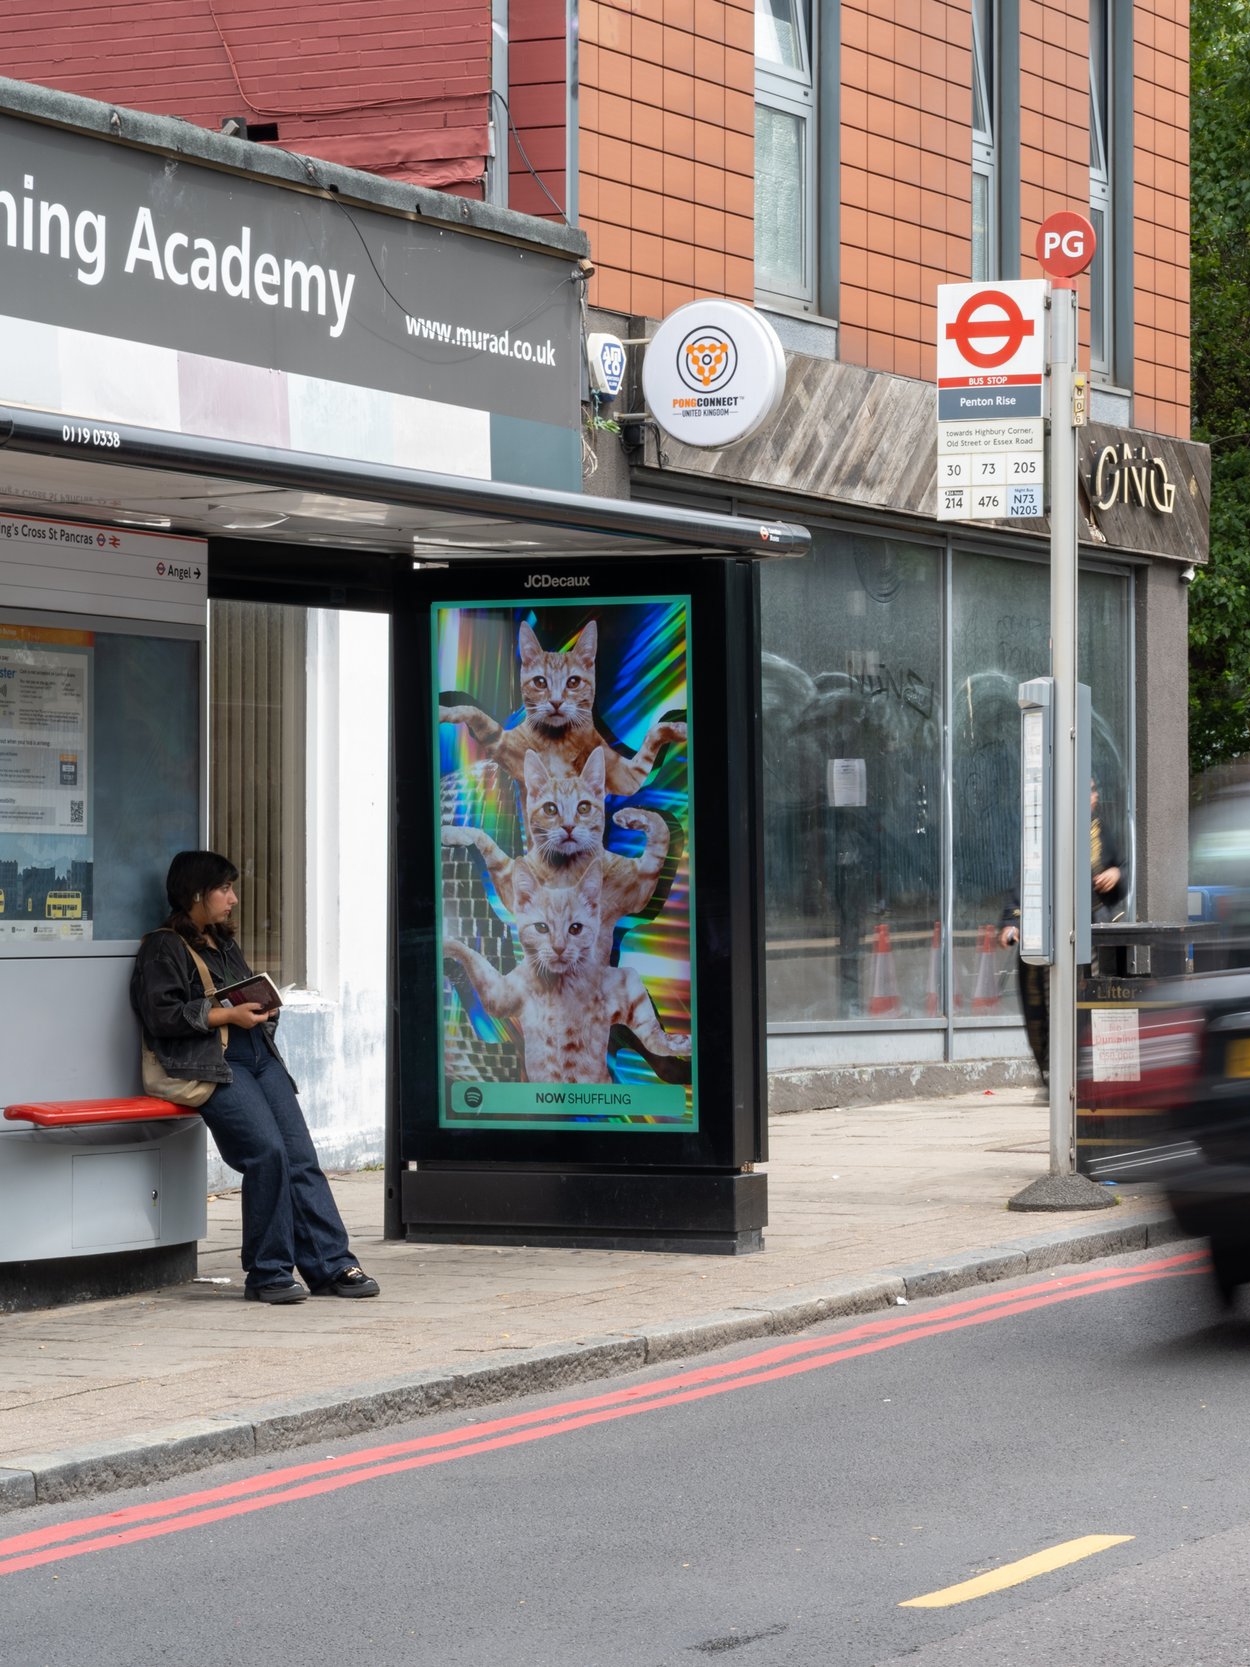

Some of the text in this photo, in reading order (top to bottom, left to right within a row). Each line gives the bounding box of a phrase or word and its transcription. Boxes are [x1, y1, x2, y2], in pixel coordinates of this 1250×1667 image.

[1043, 230, 1084, 259] PG
[124, 206, 356, 338] Academy
[405, 315, 556, 367] www.murad.co.uk
[968, 376, 1008, 386] BUS STOP
[672, 396, 739, 408] PONGCONNECT
[960, 395, 1017, 407] Penton Rise
[682, 408, 729, 418] UNITED KINGDOM
[93, 428, 120, 448] 0338
[975, 428, 1006, 437] Highbury
[946, 440, 959, 448] Old
[960, 439, 981, 447] Street
[993, 438, 1013, 446] Essex
[1015, 437, 1033, 445] Road
[947, 461, 1036, 477] 30 73 205
[945, 494, 1035, 509] 214 476 N73
[1010, 505, 1038, 516] N205
[21, 524, 47, 540] Cross
[48, 527, 58, 541] St
[60, 529, 94, 545] Pancras
[167, 564, 192, 580] Angel
[524, 574, 591, 588] JCDecaux
[1096, 985, 1138, 999] Litter
[535, 1092, 632, 1105] NOW SHUFFLING
